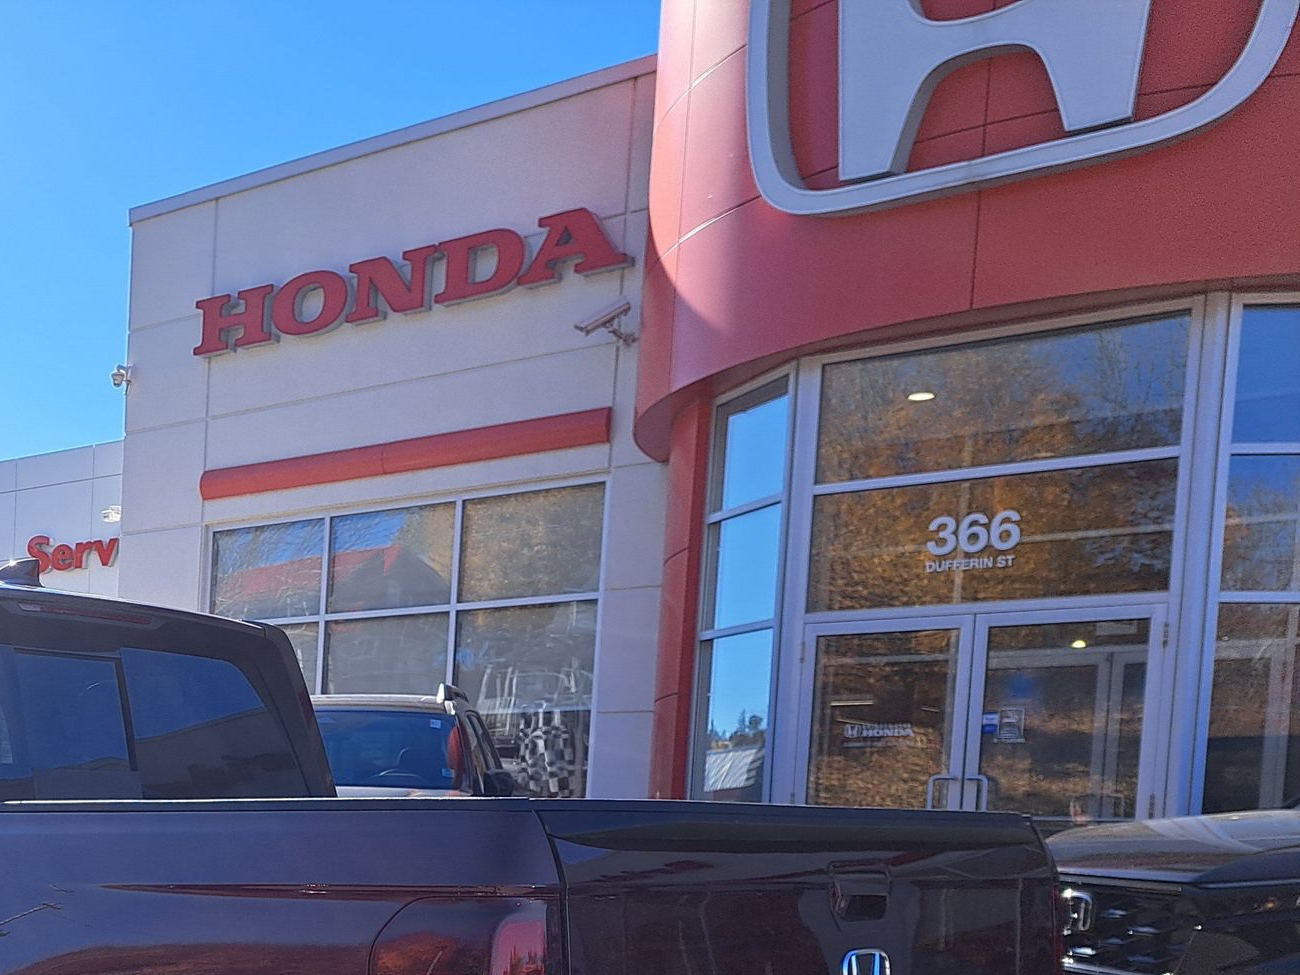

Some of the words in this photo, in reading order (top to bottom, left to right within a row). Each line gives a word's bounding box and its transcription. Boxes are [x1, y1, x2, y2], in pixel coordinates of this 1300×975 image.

[193, 207, 633, 357] HONDA
[926, 509, 1021, 556] 366
[27, 535, 119, 573] Serv
[925, 556, 993, 573] DUFFERIN
[996, 554, 1015, 568] ST
[862, 728, 915, 737] HONDA
